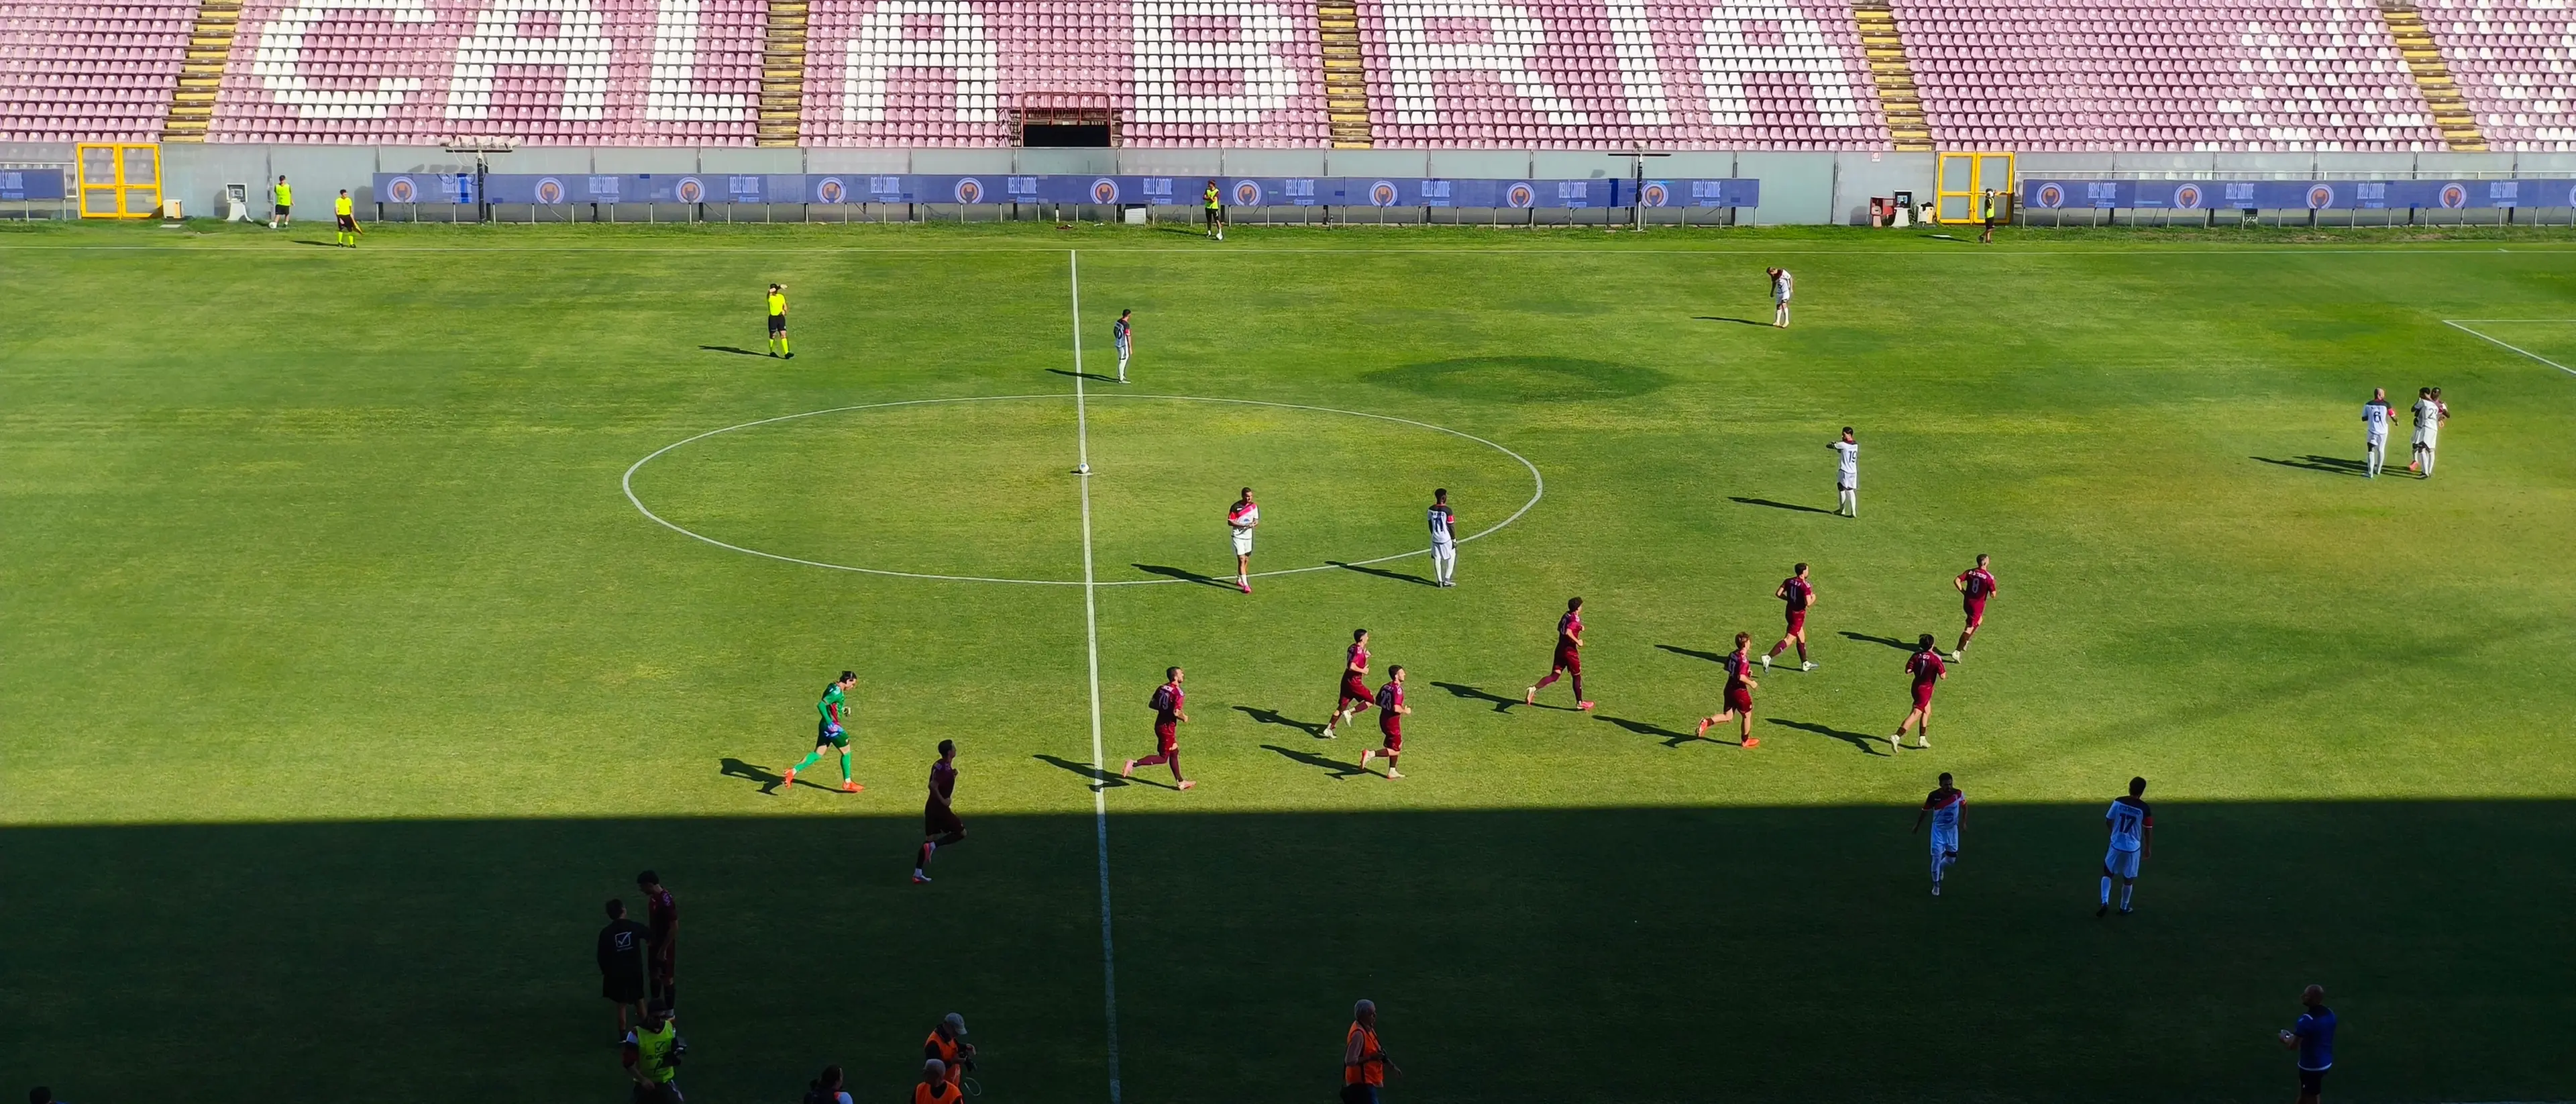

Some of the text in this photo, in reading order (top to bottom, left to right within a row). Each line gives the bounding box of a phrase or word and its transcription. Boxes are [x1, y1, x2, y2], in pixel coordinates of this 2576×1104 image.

[252, 0, 1862, 126] CALABRIA
[1849, 450, 1857, 463] 19
[1972, 578, 1979, 594] 8
[1381, 690, 1391, 711] 23
[2119, 813, 2137, 834] 17
